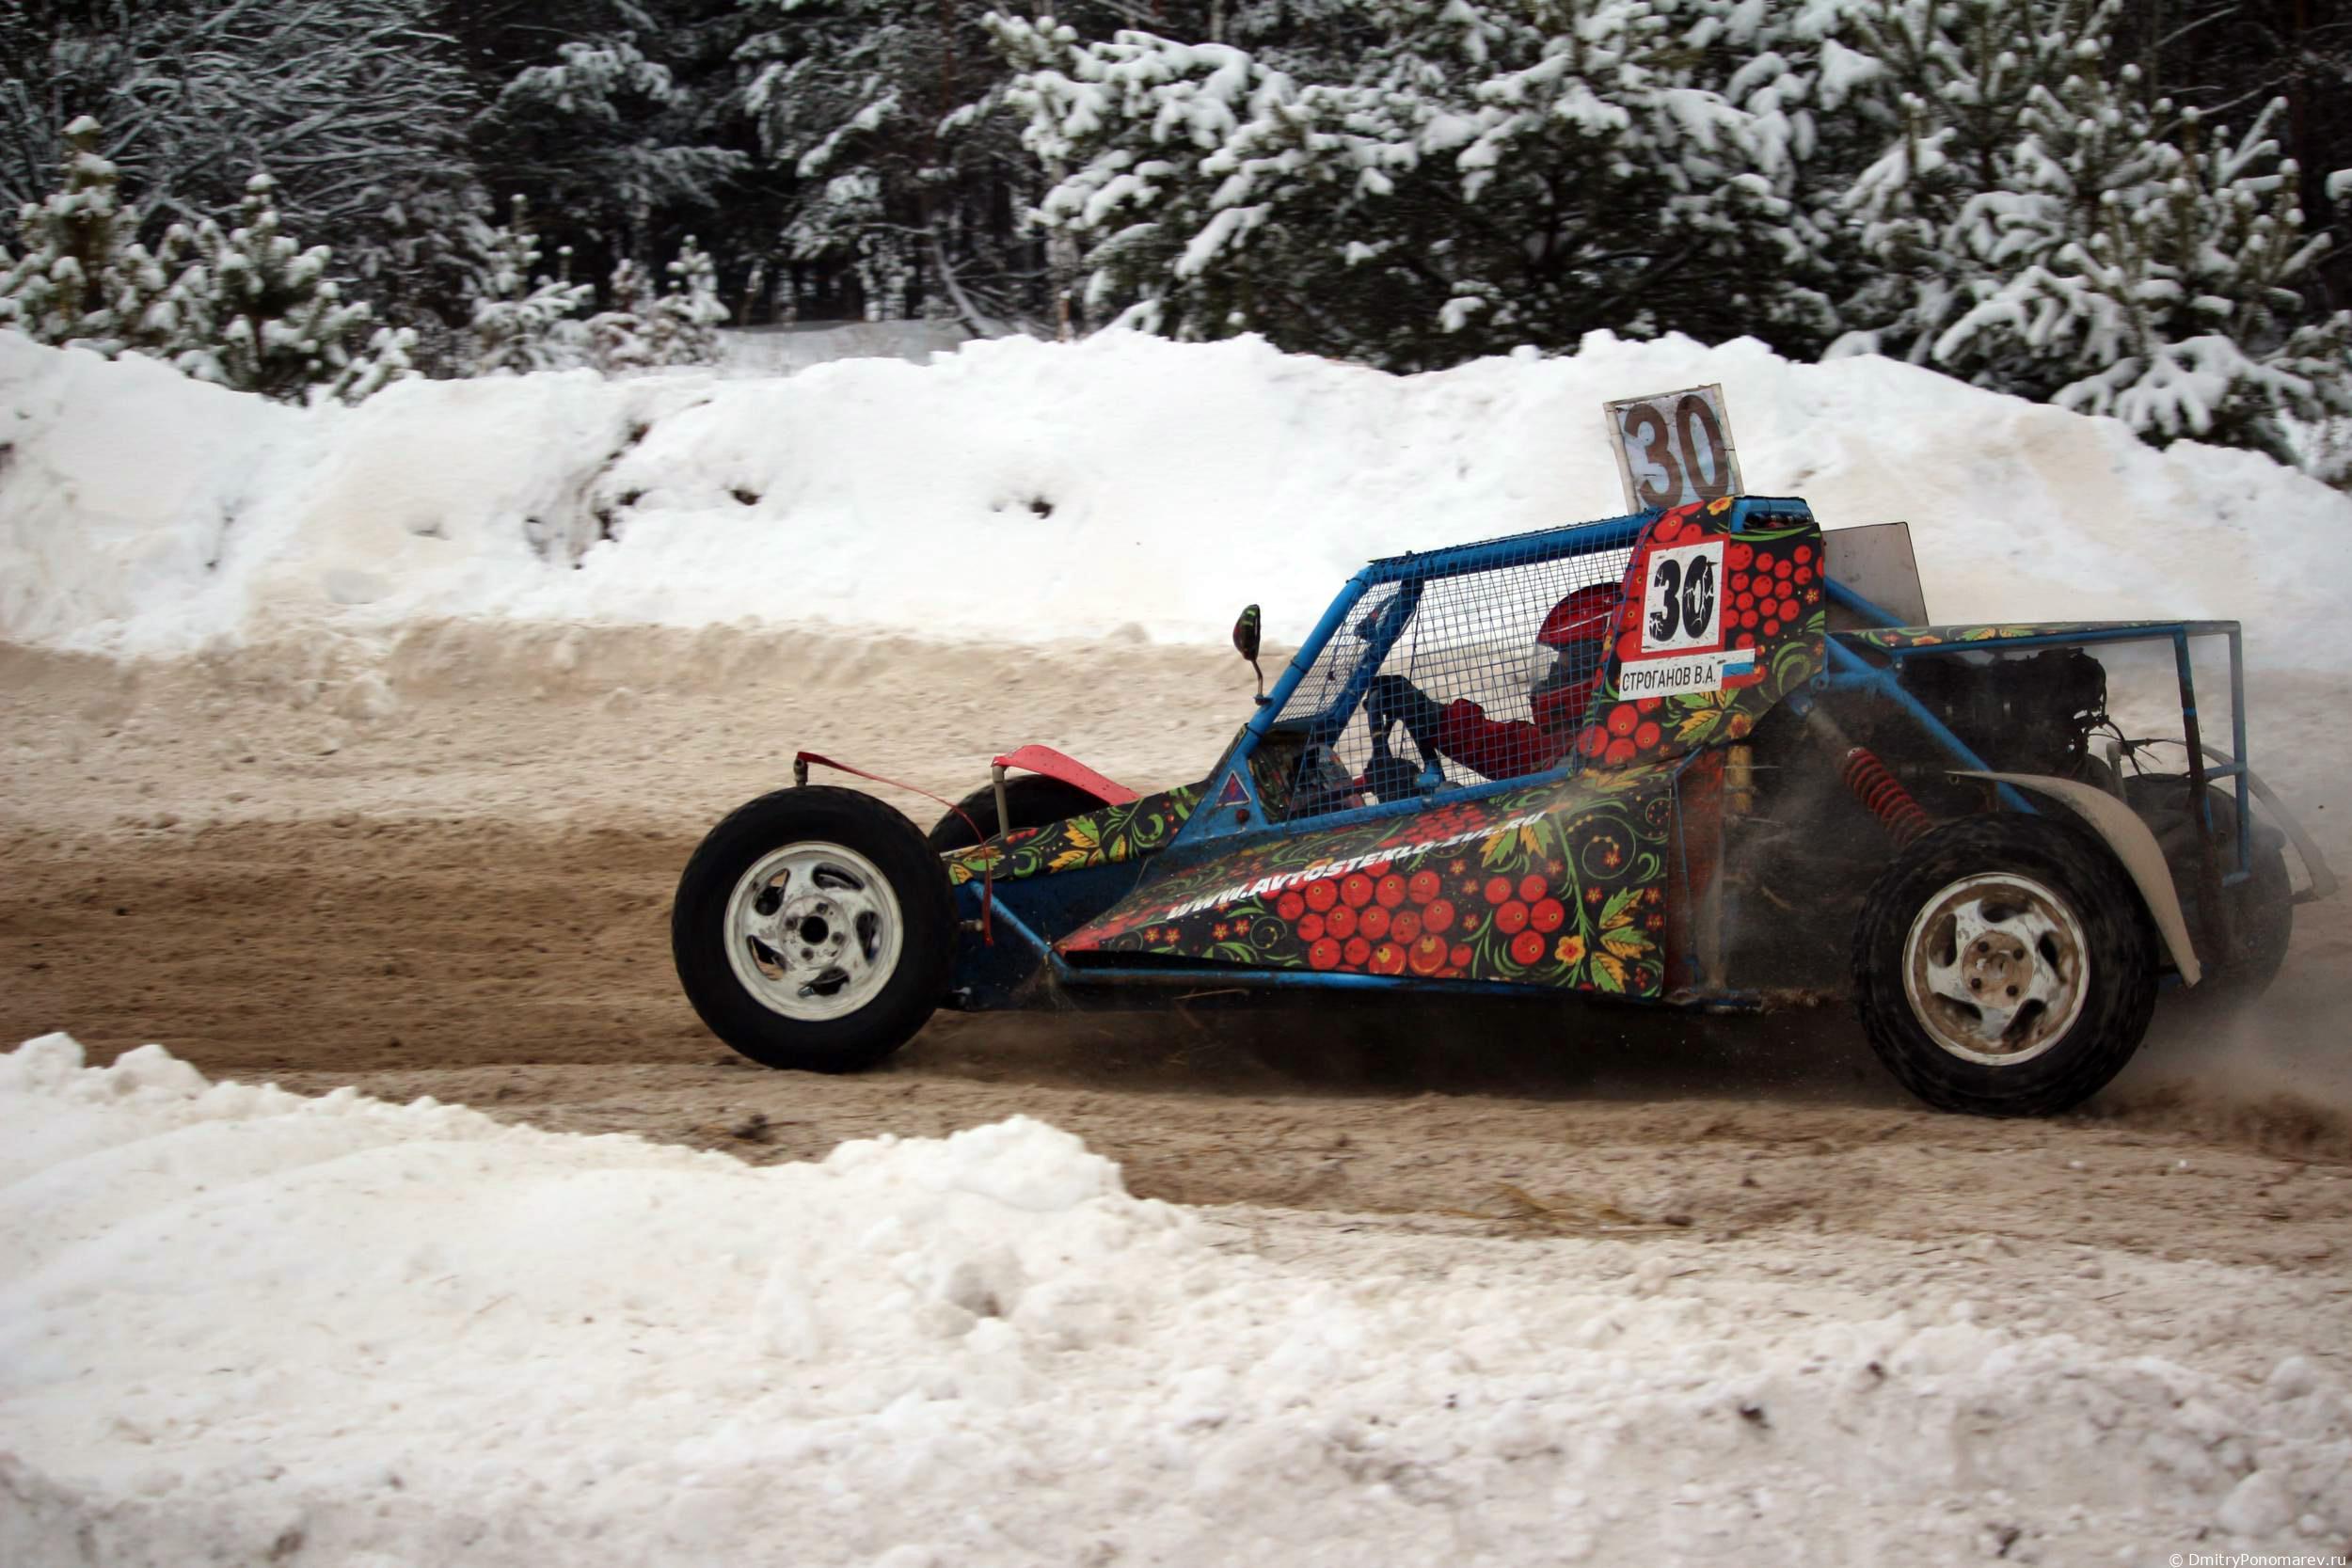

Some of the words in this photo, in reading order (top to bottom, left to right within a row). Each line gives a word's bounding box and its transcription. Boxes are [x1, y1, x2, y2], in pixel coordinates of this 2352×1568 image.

[1624, 393, 1732, 508] 30
[1649, 555, 1714, 641] 30
[1622, 667, 1692, 692] СТРОГАНОВ
[1694, 665, 1716, 685] В.А.
